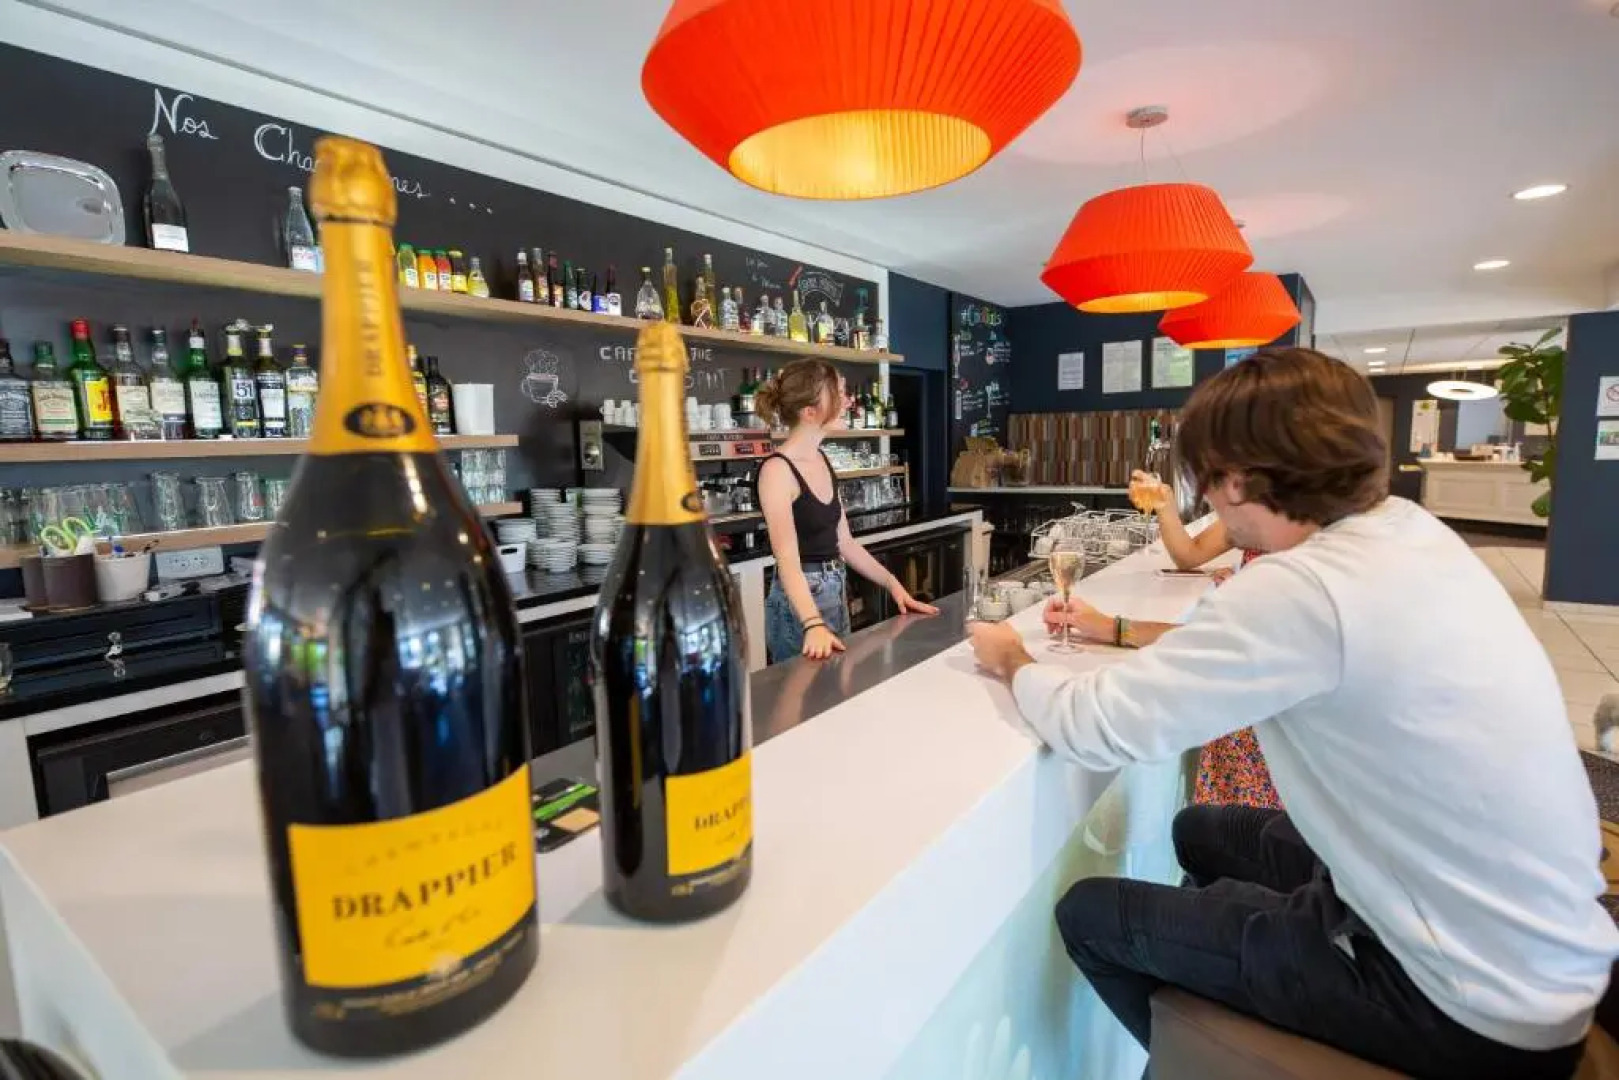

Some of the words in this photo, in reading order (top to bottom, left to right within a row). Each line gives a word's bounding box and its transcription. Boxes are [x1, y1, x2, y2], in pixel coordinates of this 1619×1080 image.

[150, 88, 219, 139] Nos
[235, 382, 254, 398] 51
[331, 842, 517, 921] DRAPPIER
